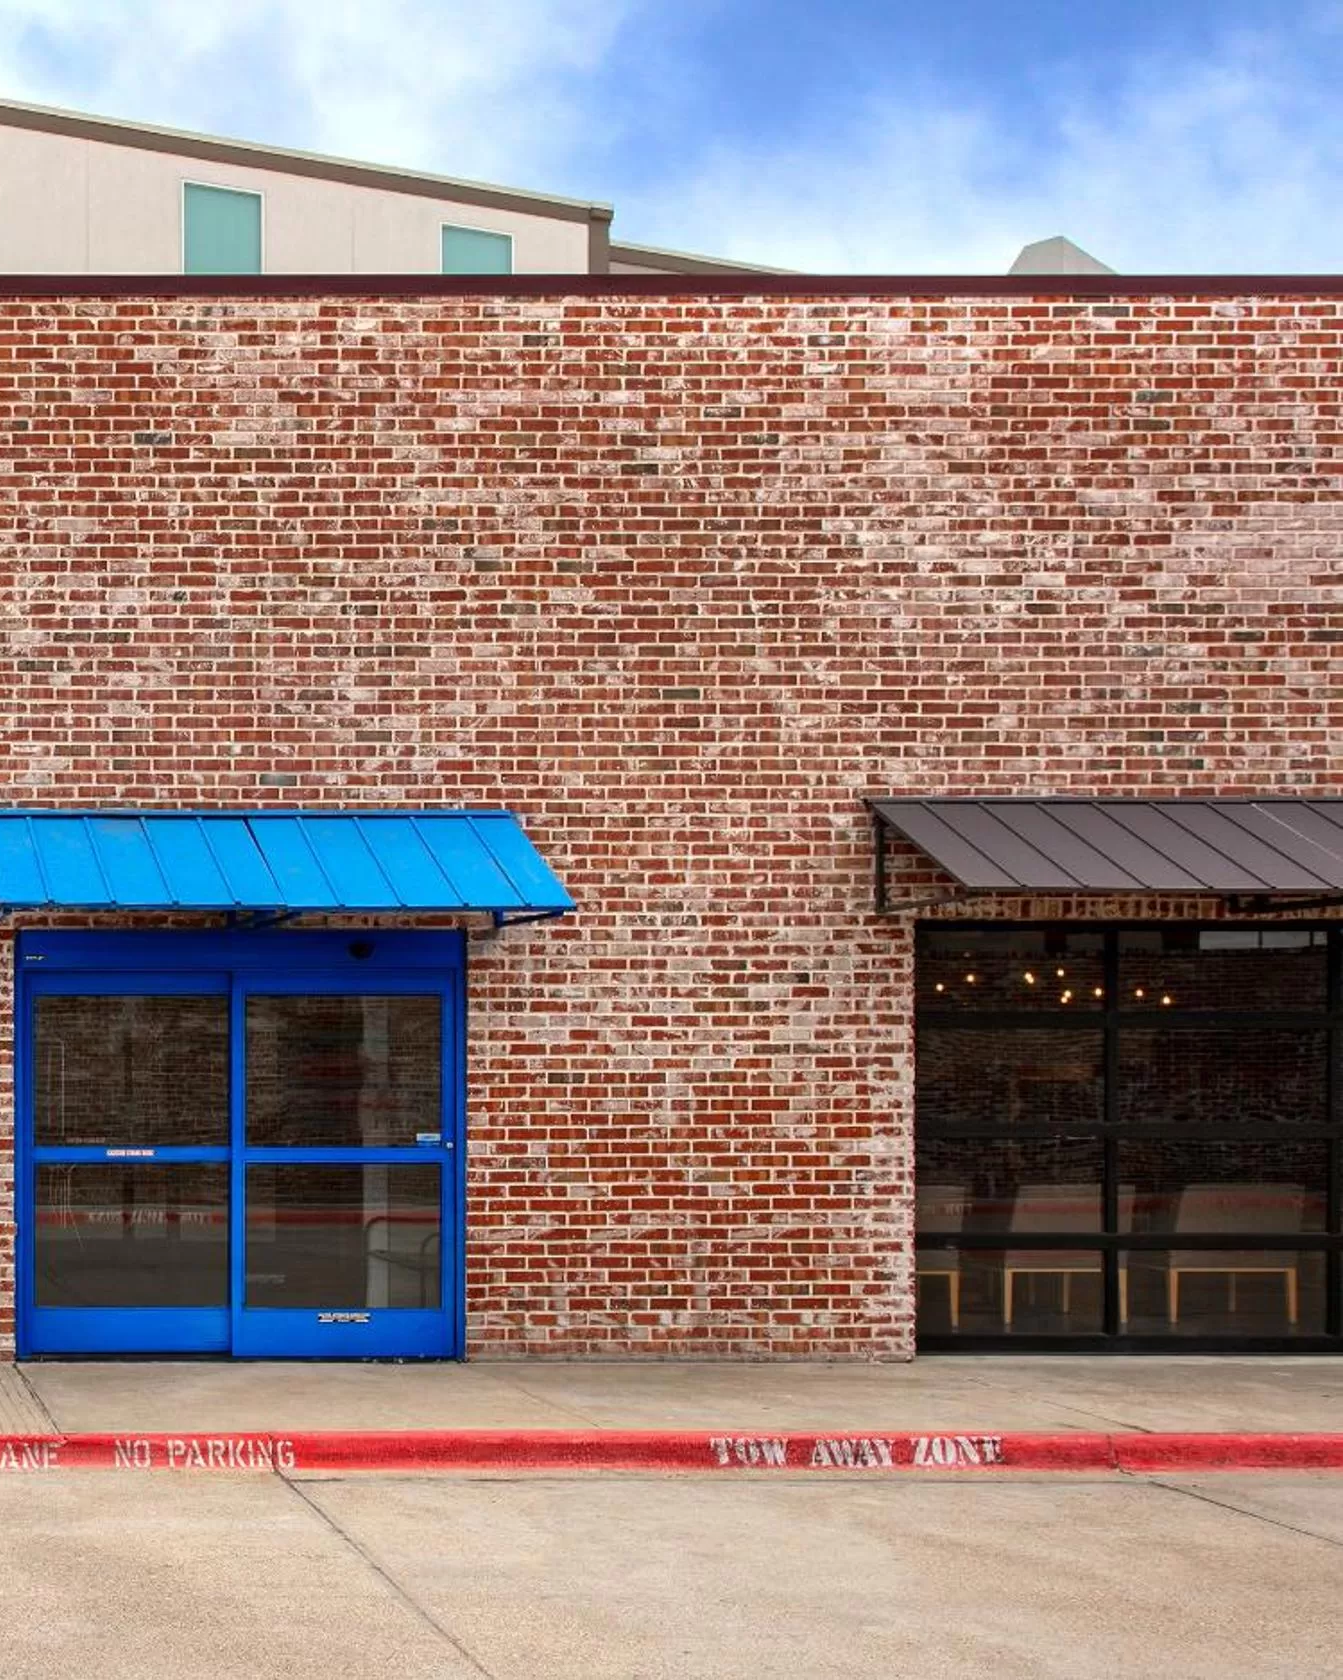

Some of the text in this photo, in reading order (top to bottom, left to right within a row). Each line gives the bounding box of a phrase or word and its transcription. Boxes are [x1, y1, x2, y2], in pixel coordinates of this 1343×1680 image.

[114, 1439, 151, 1468] NO
[167, 1439, 295, 1469] PARKING
[710, 1435, 1007, 1467] TOW AWAY ZONE
